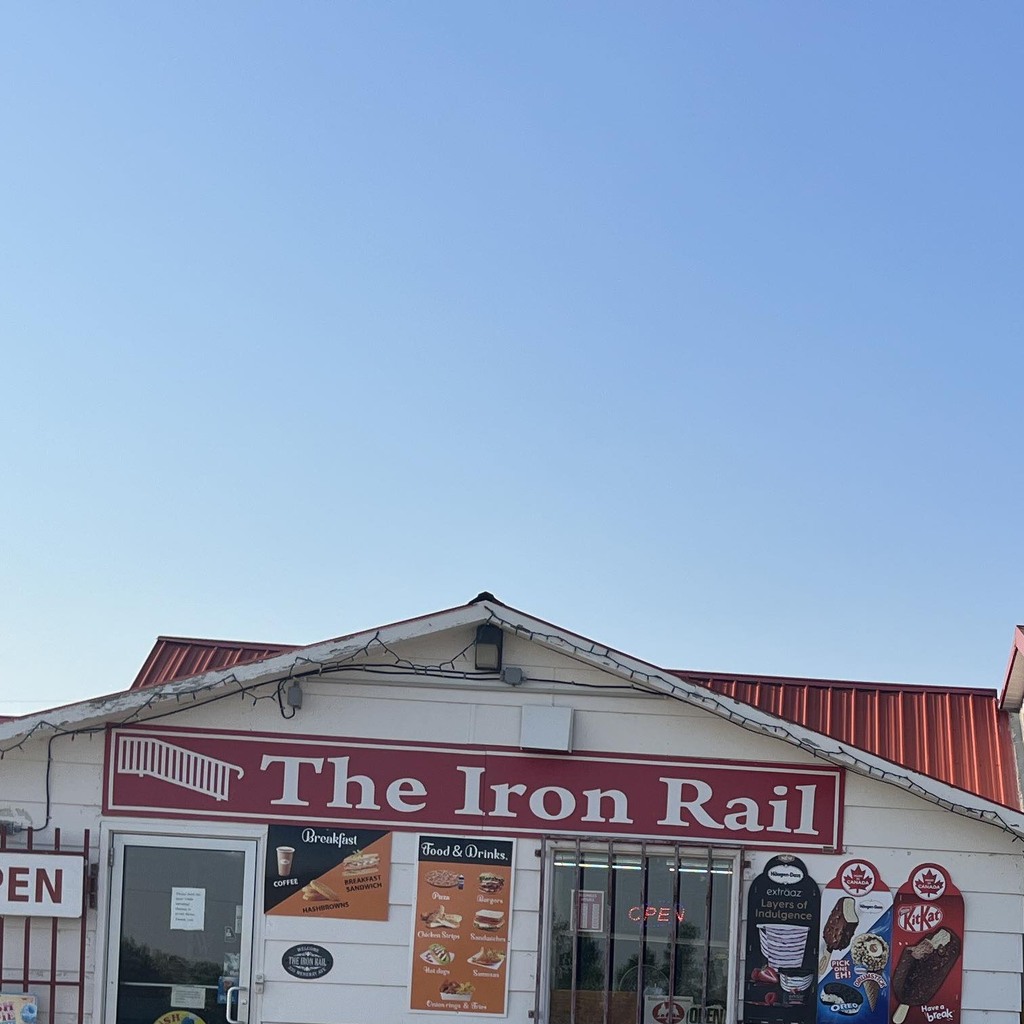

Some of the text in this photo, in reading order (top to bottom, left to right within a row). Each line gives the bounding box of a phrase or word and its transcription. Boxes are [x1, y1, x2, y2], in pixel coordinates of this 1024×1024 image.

[260, 754, 819, 836] The Iron Rail
[301, 828, 357, 848] Breakfast
[421, 842, 450, 856] Food
[452, 845, 462, 857] &
[0, 867, 63, 904] EN
[273, 878, 298, 888] COFFEE
[344, 875, 382, 886] BREAKFAST
[346, 882, 382, 892] SANDWICH
[302, 902, 350, 914] HASHBROWNS
[761, 898, 808, 910] Layers of
[755, 909, 812, 920] Indulgence
[899, 905, 941, 932] KitKat
[417, 930, 440, 939] Chicken
[831, 960, 850, 968] PICK
[834, 972, 852, 980] EH!
[830, 1002, 858, 1012] OREO
[920, 1005, 940, 1013] Have
[926, 1010, 953, 1022] break
